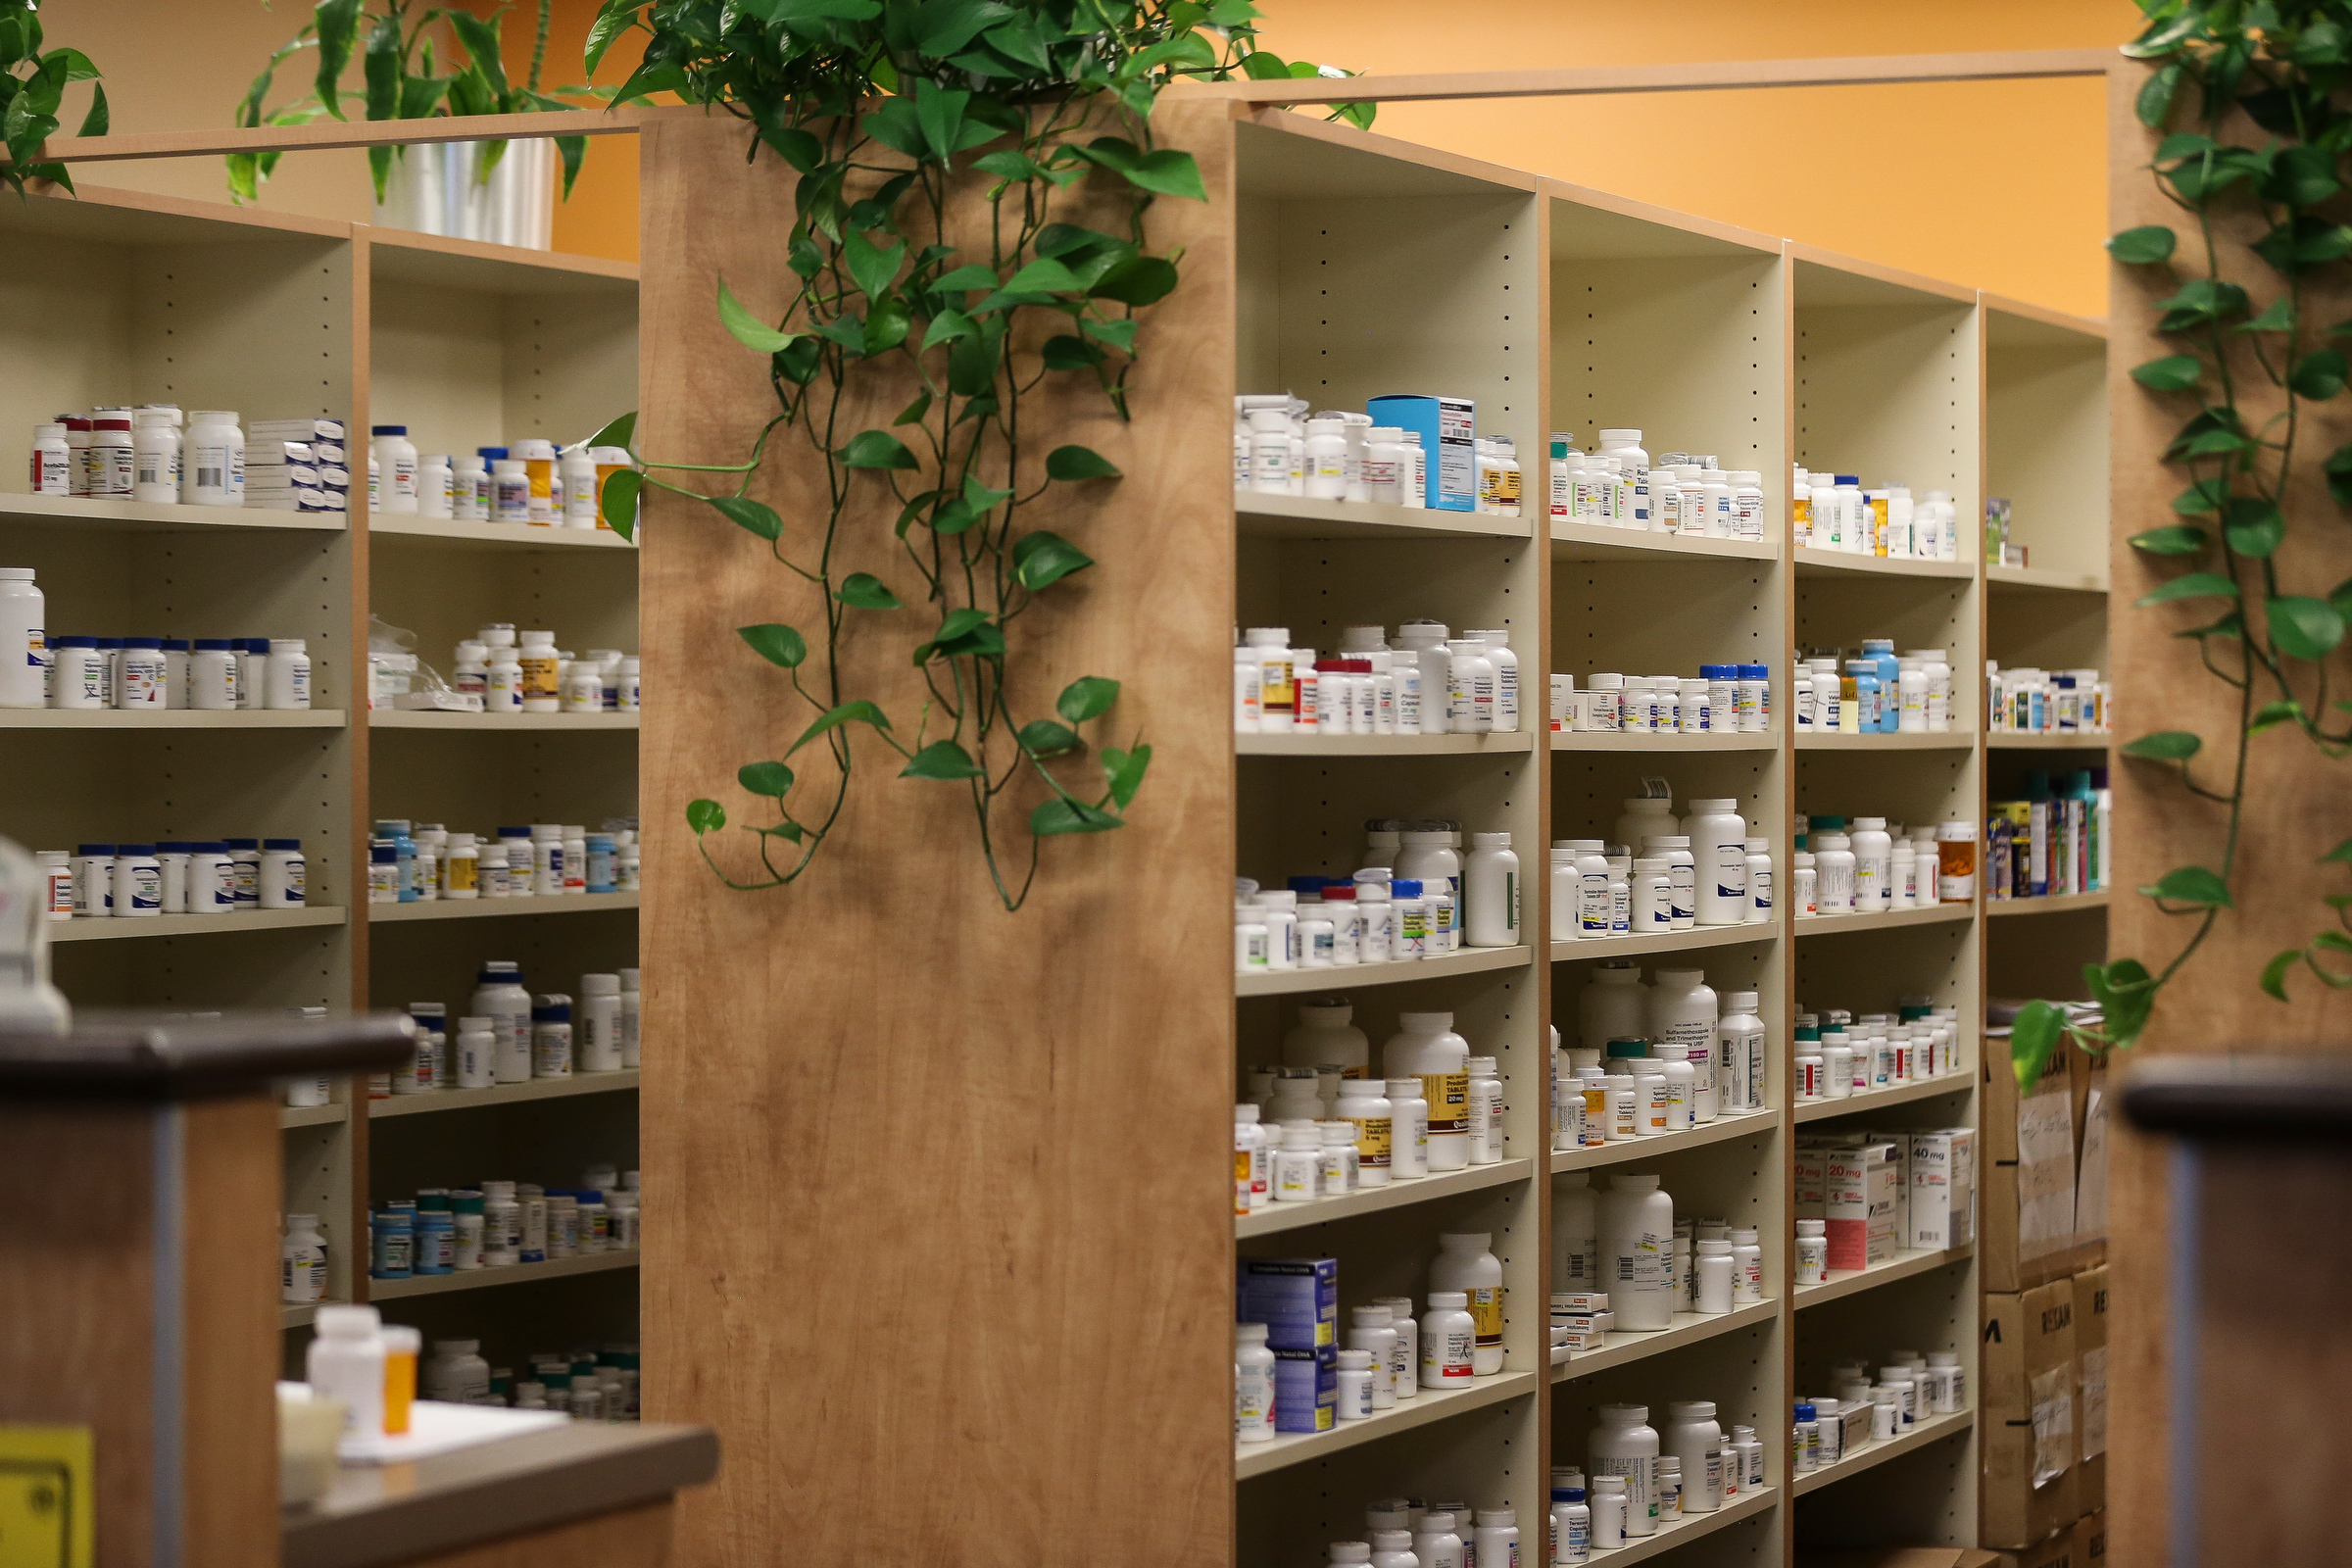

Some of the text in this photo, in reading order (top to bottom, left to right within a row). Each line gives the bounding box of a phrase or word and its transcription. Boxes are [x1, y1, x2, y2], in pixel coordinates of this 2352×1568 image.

[1914, 1148, 1945, 1161] 40 mg
[1805, 1169, 1821, 1179] mg
[1829, 1164, 1862, 1179] 20 mg
